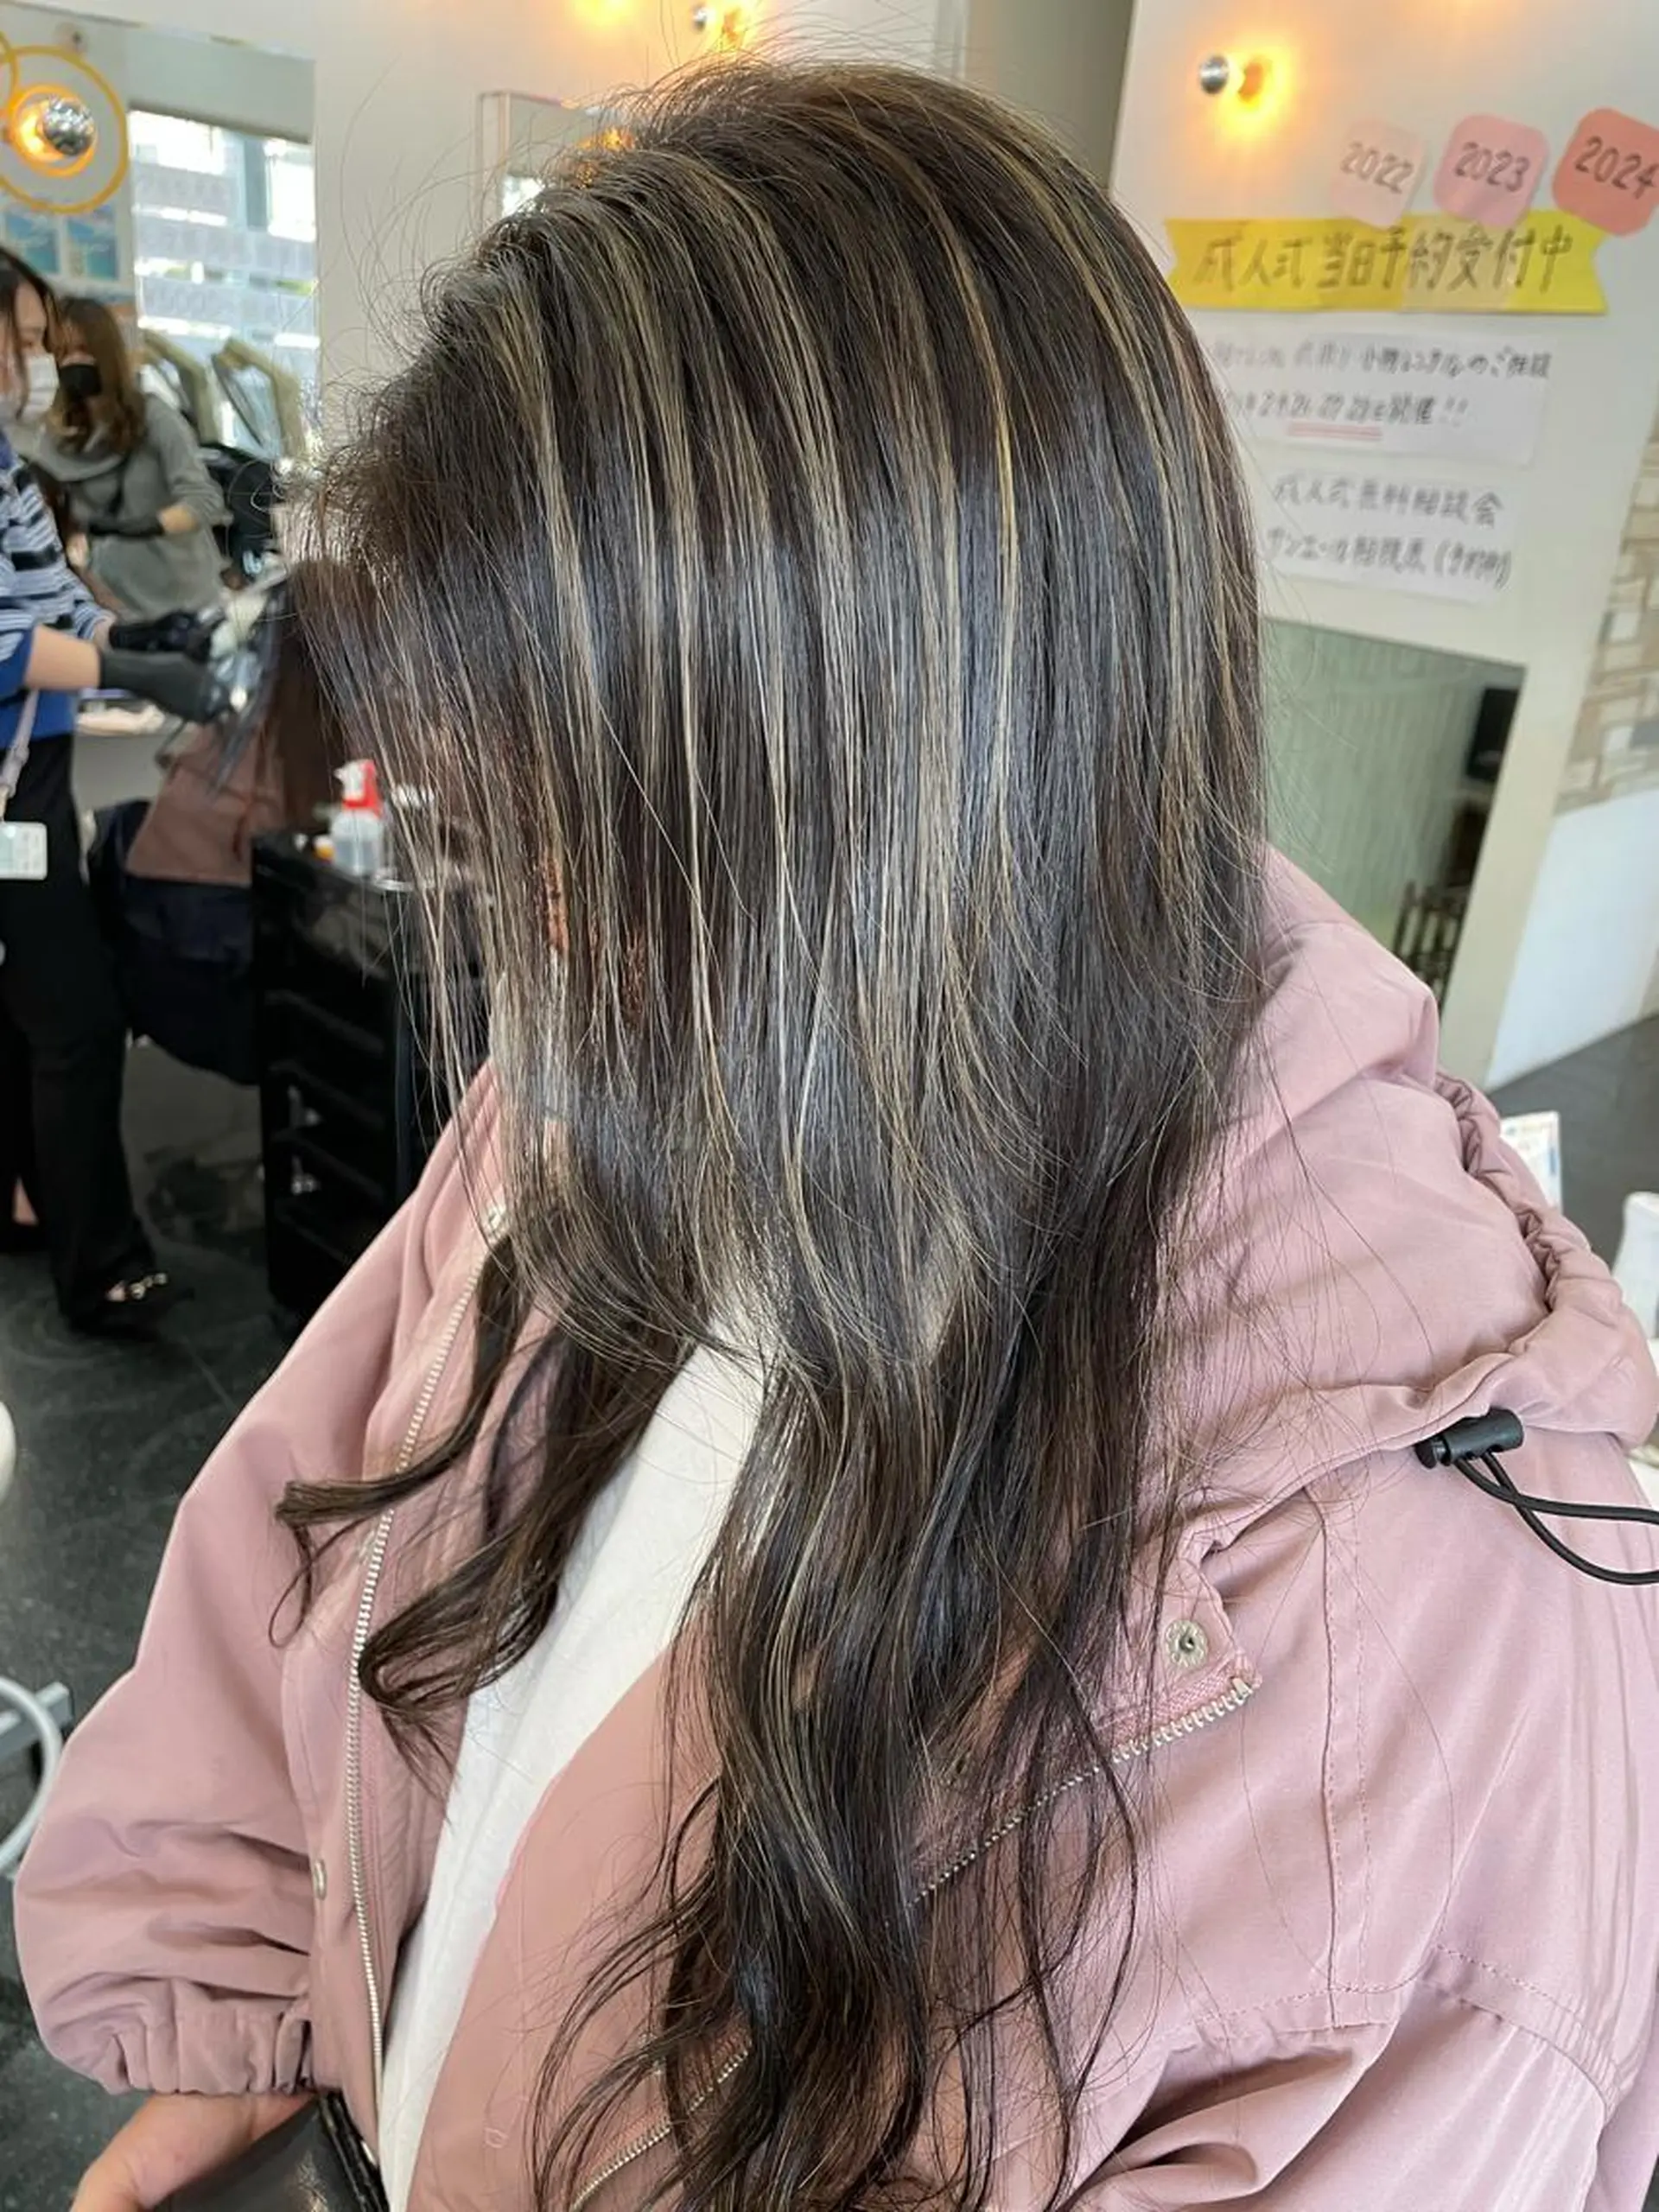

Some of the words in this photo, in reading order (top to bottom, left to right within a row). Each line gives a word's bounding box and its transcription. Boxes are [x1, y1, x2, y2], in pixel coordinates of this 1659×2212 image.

[1339, 140, 1414, 195] 2022
[1452, 140, 1530, 194] 2023
[1573, 134, 1659, 200] 2024
[1192, 222, 1573, 296] 成人式当日予約受付中
